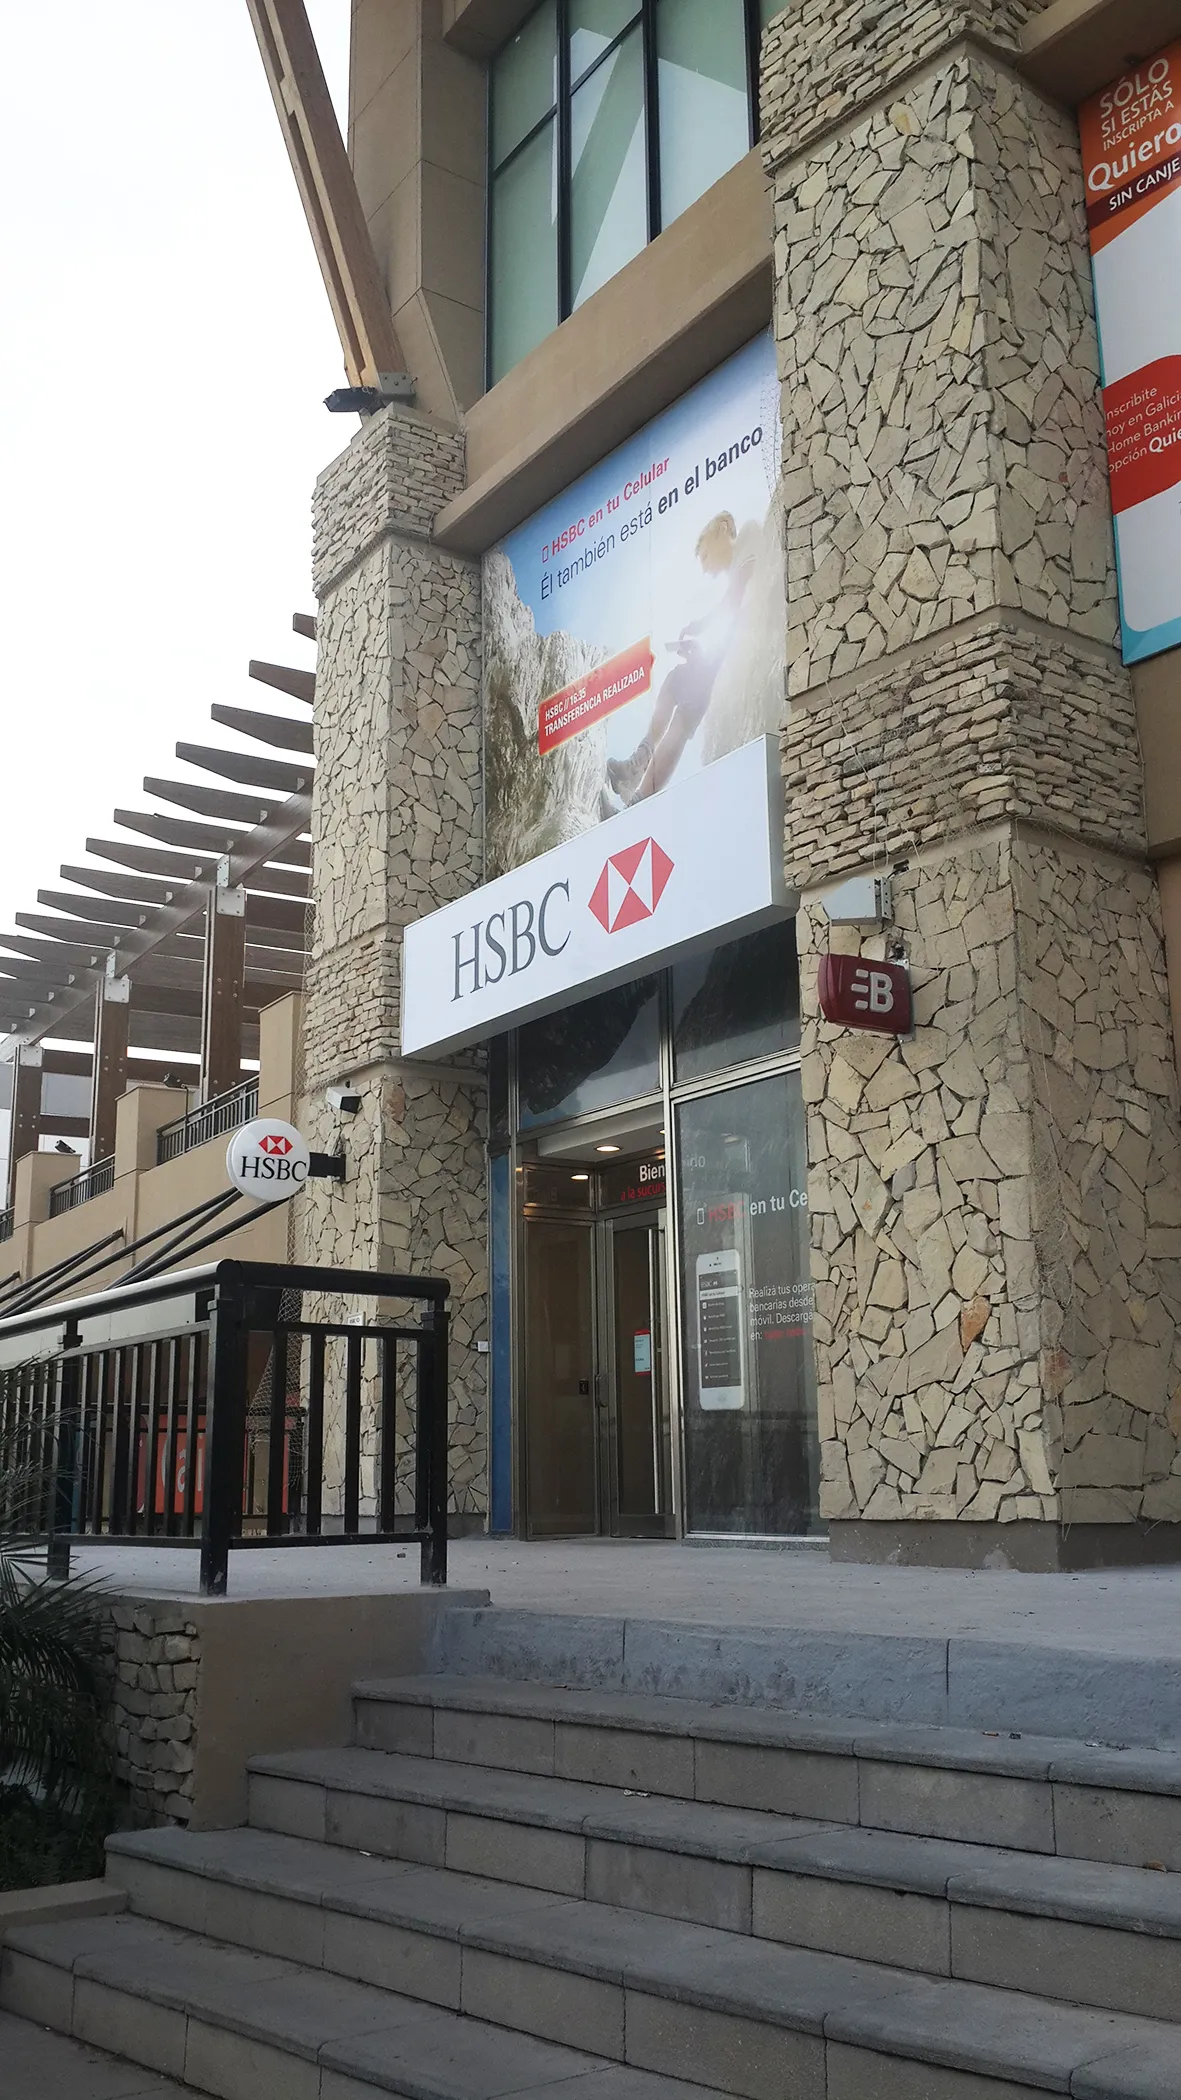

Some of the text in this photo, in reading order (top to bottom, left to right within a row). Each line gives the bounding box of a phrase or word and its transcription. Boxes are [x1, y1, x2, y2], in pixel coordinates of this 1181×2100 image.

[1100, 58, 1169, 118] SÓLO
[1101, 80, 1173, 138] SI ESTÁS
[1103, 100, 1175, 151] INSCRIPTA A
[1088, 122, 1181, 191] Quiero
[1109, 157, 1181, 211] SIN CANJE
[1128, 413, 1143, 427] en
[1145, 390, 1181, 417] Galici
[541, 426, 764, 601] Él también está en el banco
[551, 457, 670, 557] HSBC en tu Celular
[544, 666, 645, 737] TRANSFERENCIA REALIZADA
[545, 701, 564, 721] HSBC
[450, 877, 572, 1002] HSBC
[240, 1156, 307, 1182] HSBC
[750, 1200, 766, 1216] en
[769, 1195, 785, 1212] tu
[750, 1295, 814, 1312] bancarias desde
[778, 1285, 791, 1295] tus
